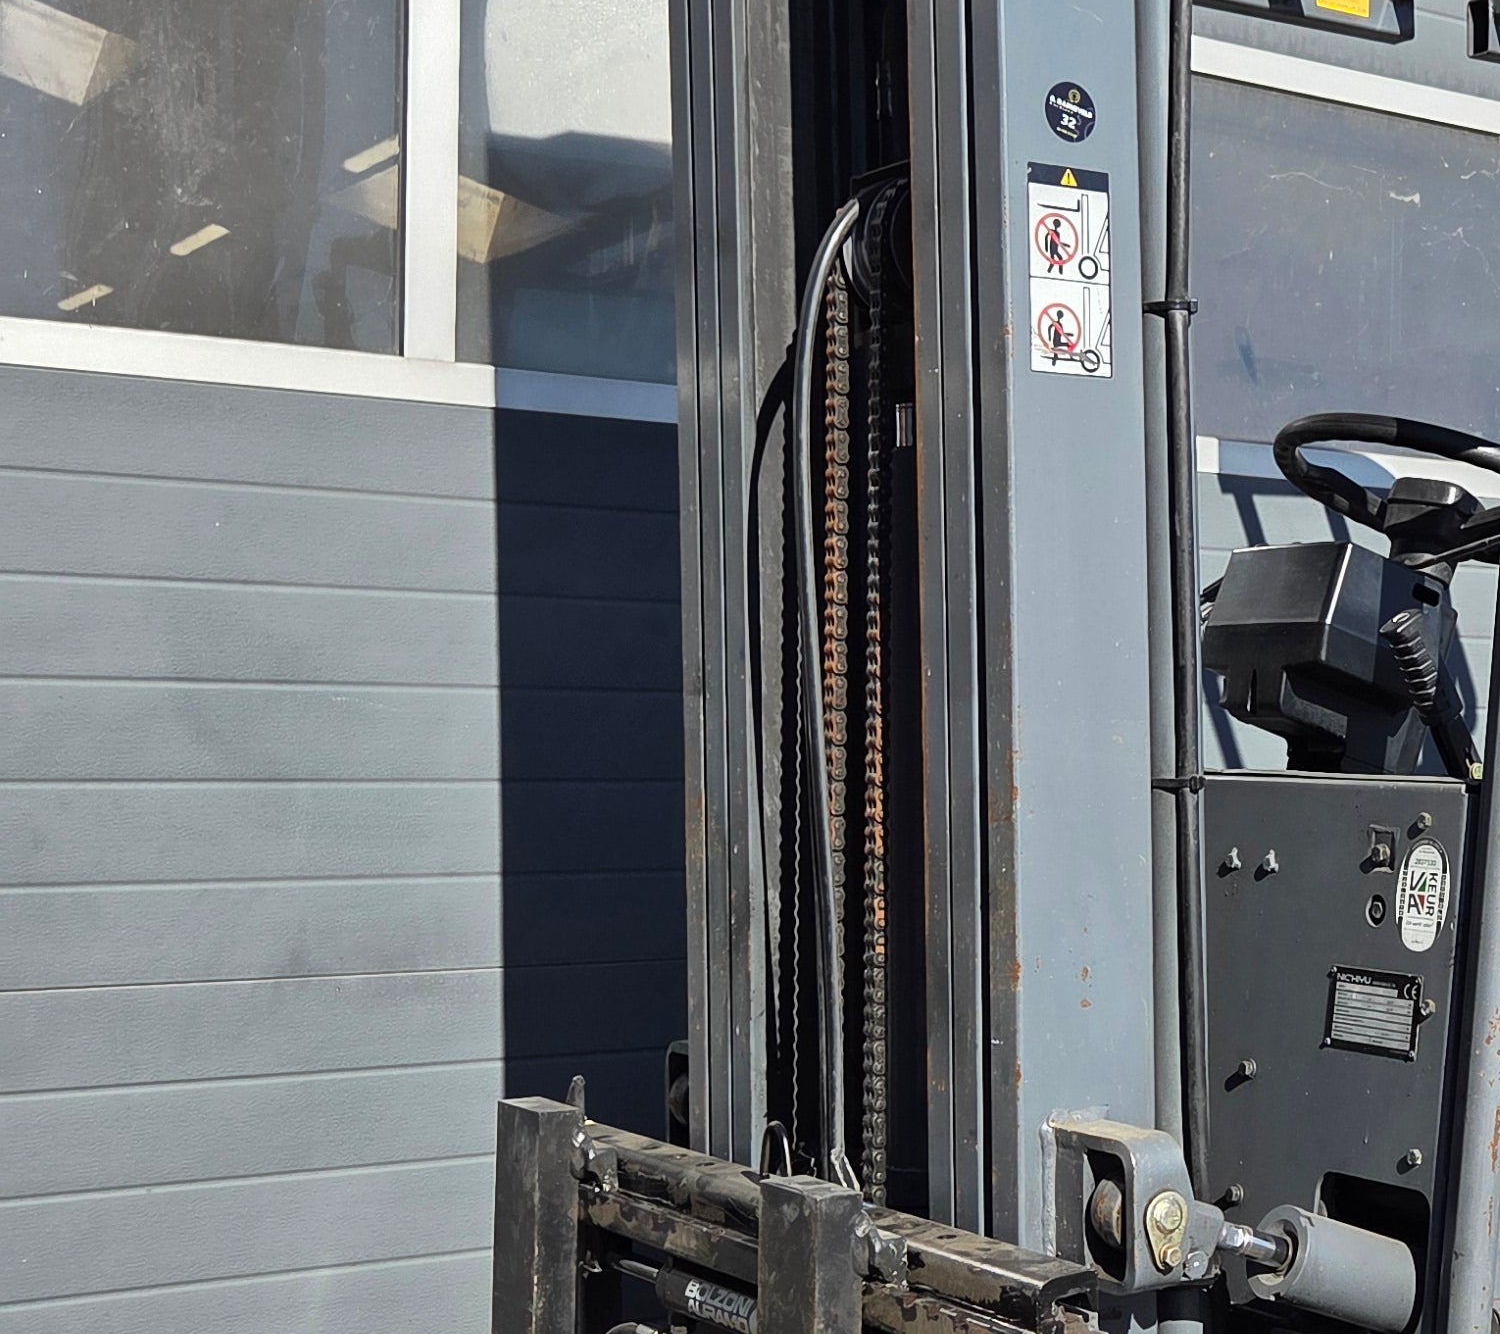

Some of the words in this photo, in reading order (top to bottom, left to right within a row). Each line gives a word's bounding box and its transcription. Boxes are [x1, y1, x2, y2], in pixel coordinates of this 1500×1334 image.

[1060, 113, 1077, 130] 32
[1425, 872, 1439, 917] KEUR
[1336, 972, 1373, 985] NICHIYU
[684, 1278, 755, 1318] BOLZONI
[687, 1298, 750, 1334] AURAMO
